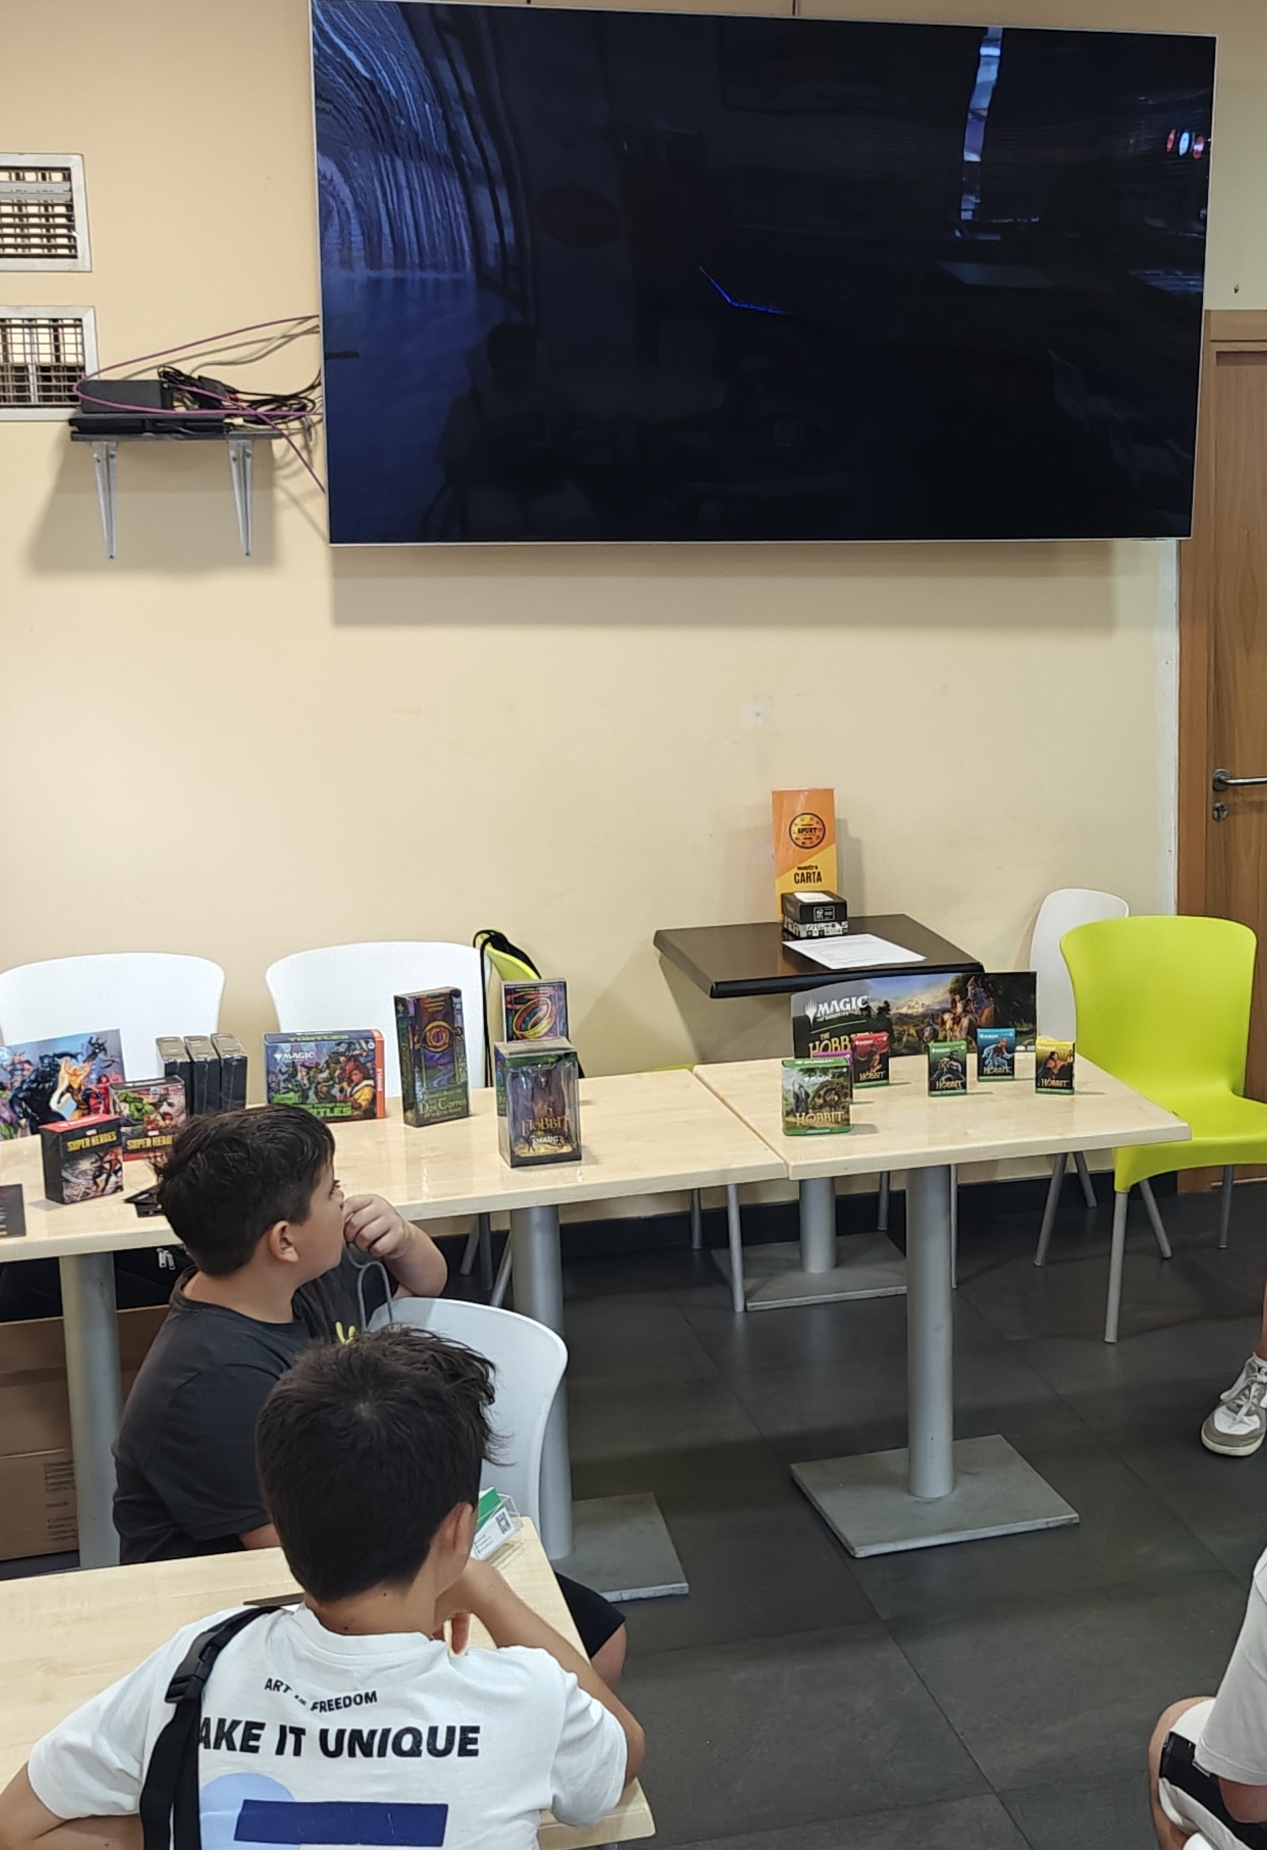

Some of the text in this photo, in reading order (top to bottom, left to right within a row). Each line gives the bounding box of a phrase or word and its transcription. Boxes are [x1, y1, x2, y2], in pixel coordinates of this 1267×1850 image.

[793, 871, 823, 885] CARTA
[816, 995, 869, 1018] MAGIC
[808, 1035, 851, 1059] HOBB
[795, 1110, 845, 1127] HOBBIT
[66, 1137, 91, 1152] SUPER
[126, 1138, 152, 1151] SUPER
[264, 1677, 292, 1694] ART
[310, 1690, 378, 1713] FREEDOM
[199, 1716, 481, 1758] AKE IT UNIQUE
